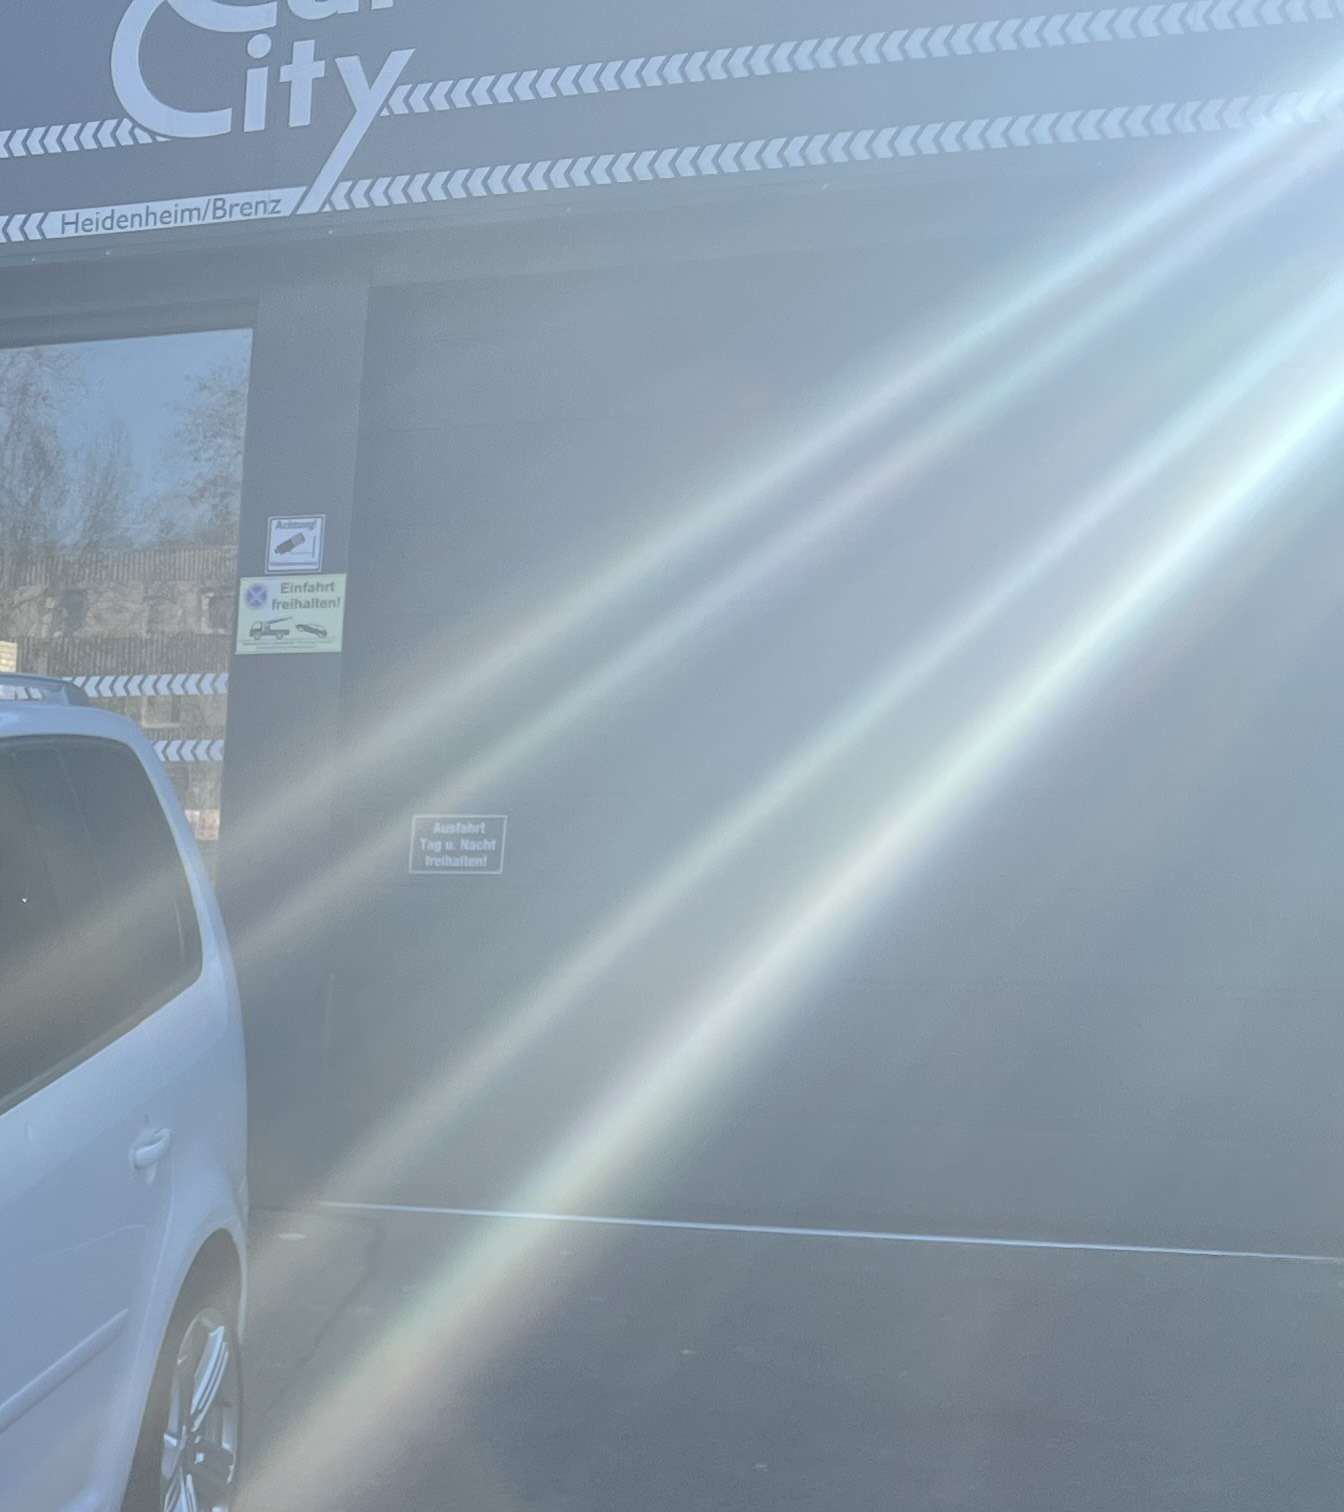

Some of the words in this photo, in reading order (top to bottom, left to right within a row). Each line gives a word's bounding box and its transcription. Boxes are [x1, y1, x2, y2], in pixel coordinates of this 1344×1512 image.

[60, 195, 283, 236] Heidenheim/Brenz
[279, 581, 335, 594] Einfahrt
[272, 597, 341, 610] freihalten!
